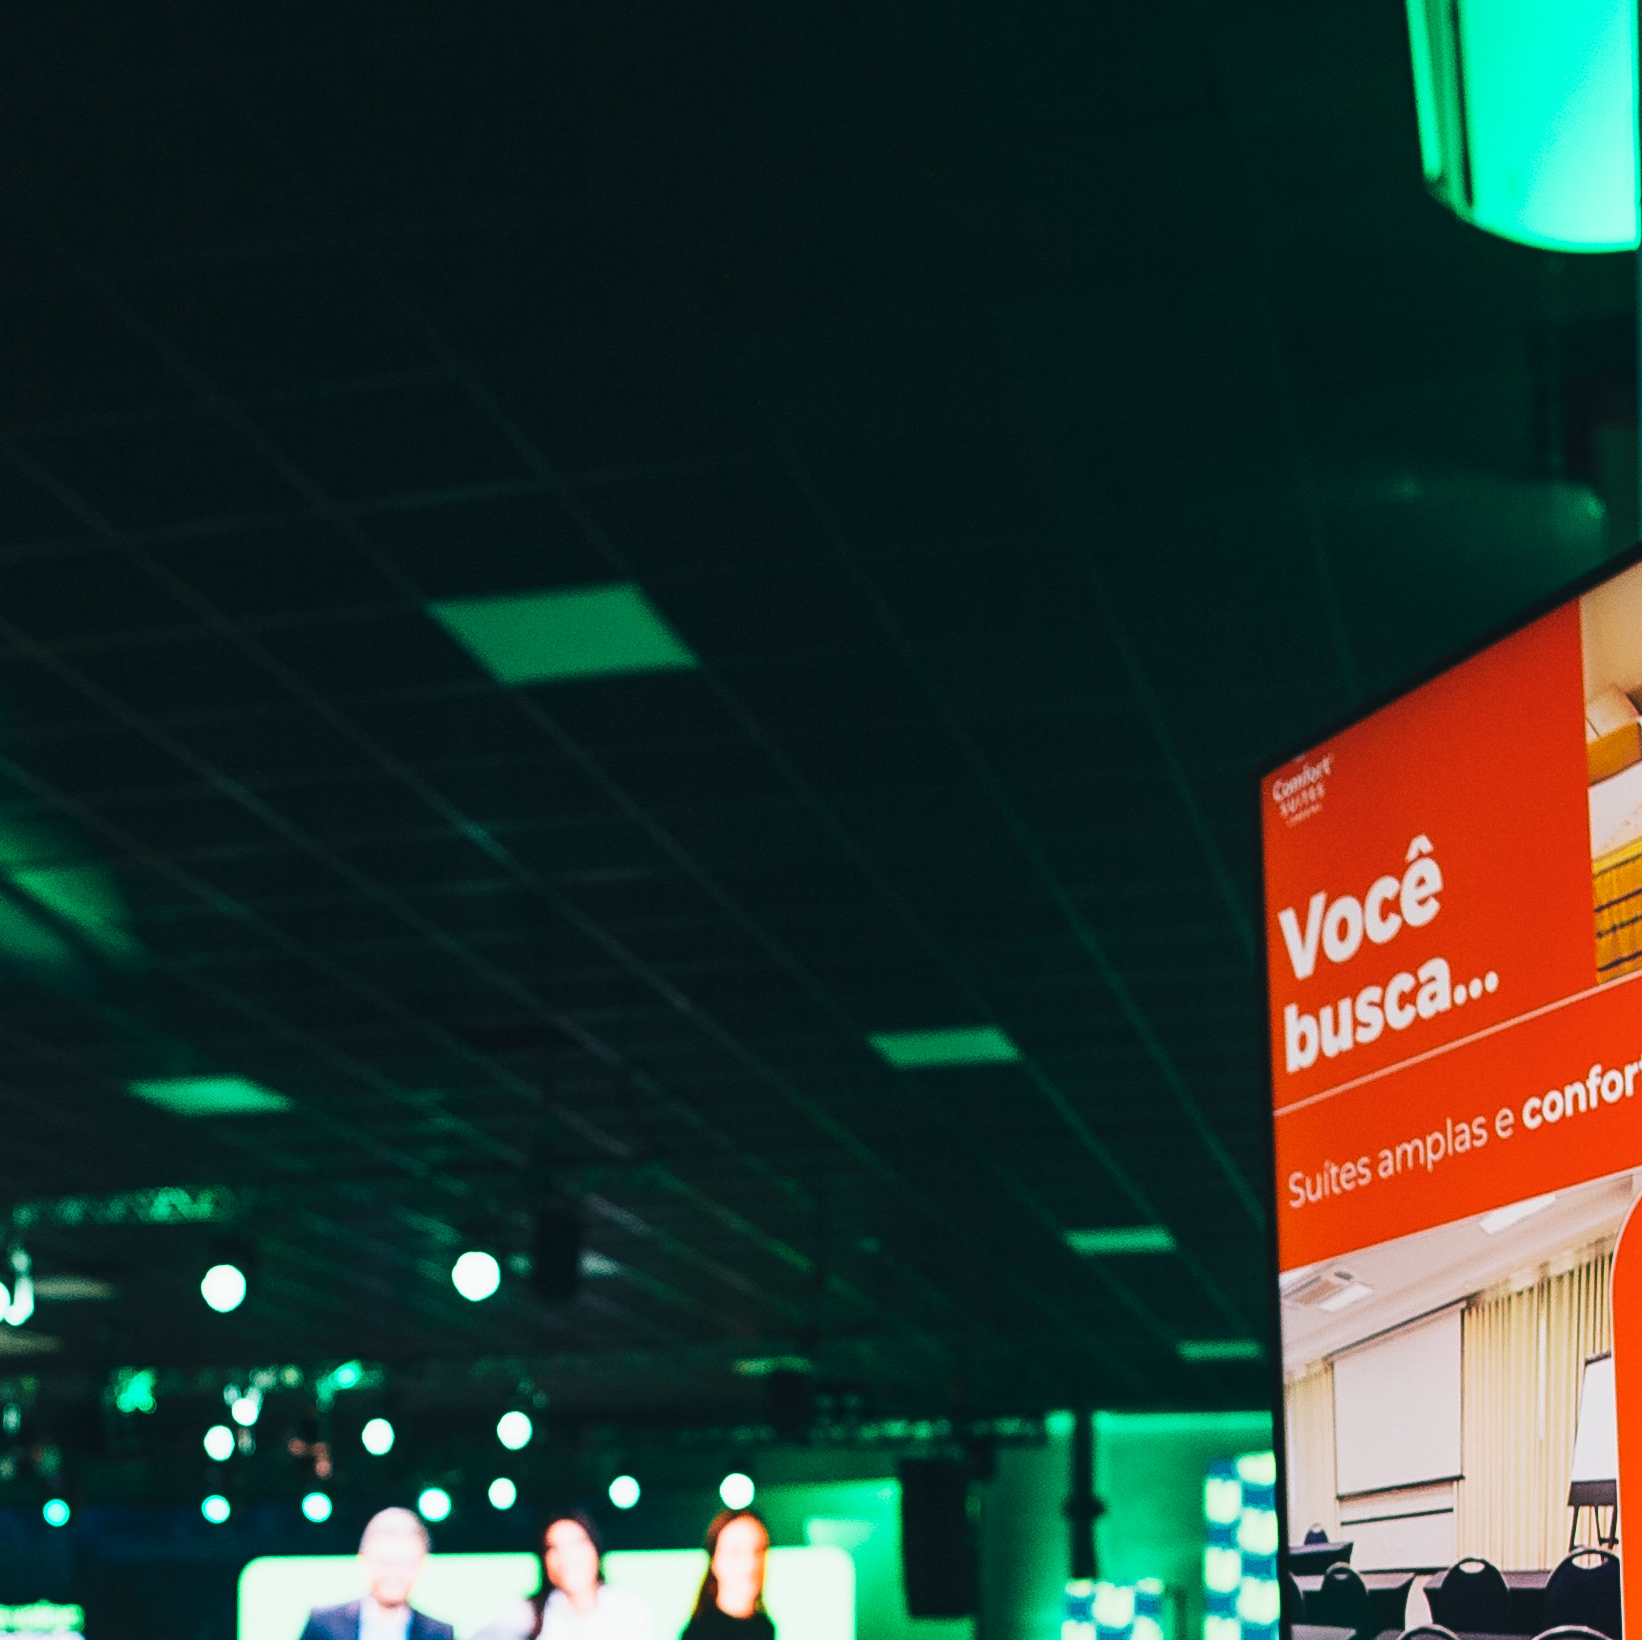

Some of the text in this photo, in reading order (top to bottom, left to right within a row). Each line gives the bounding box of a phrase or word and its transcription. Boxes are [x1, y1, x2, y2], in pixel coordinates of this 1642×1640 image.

[1277, 833, 1444, 981] Você
[1283, 957, 1500, 1074] busca...
[1378, 1116, 1489, 1174] amplas
[1495, 1107, 1515, 1139] e
